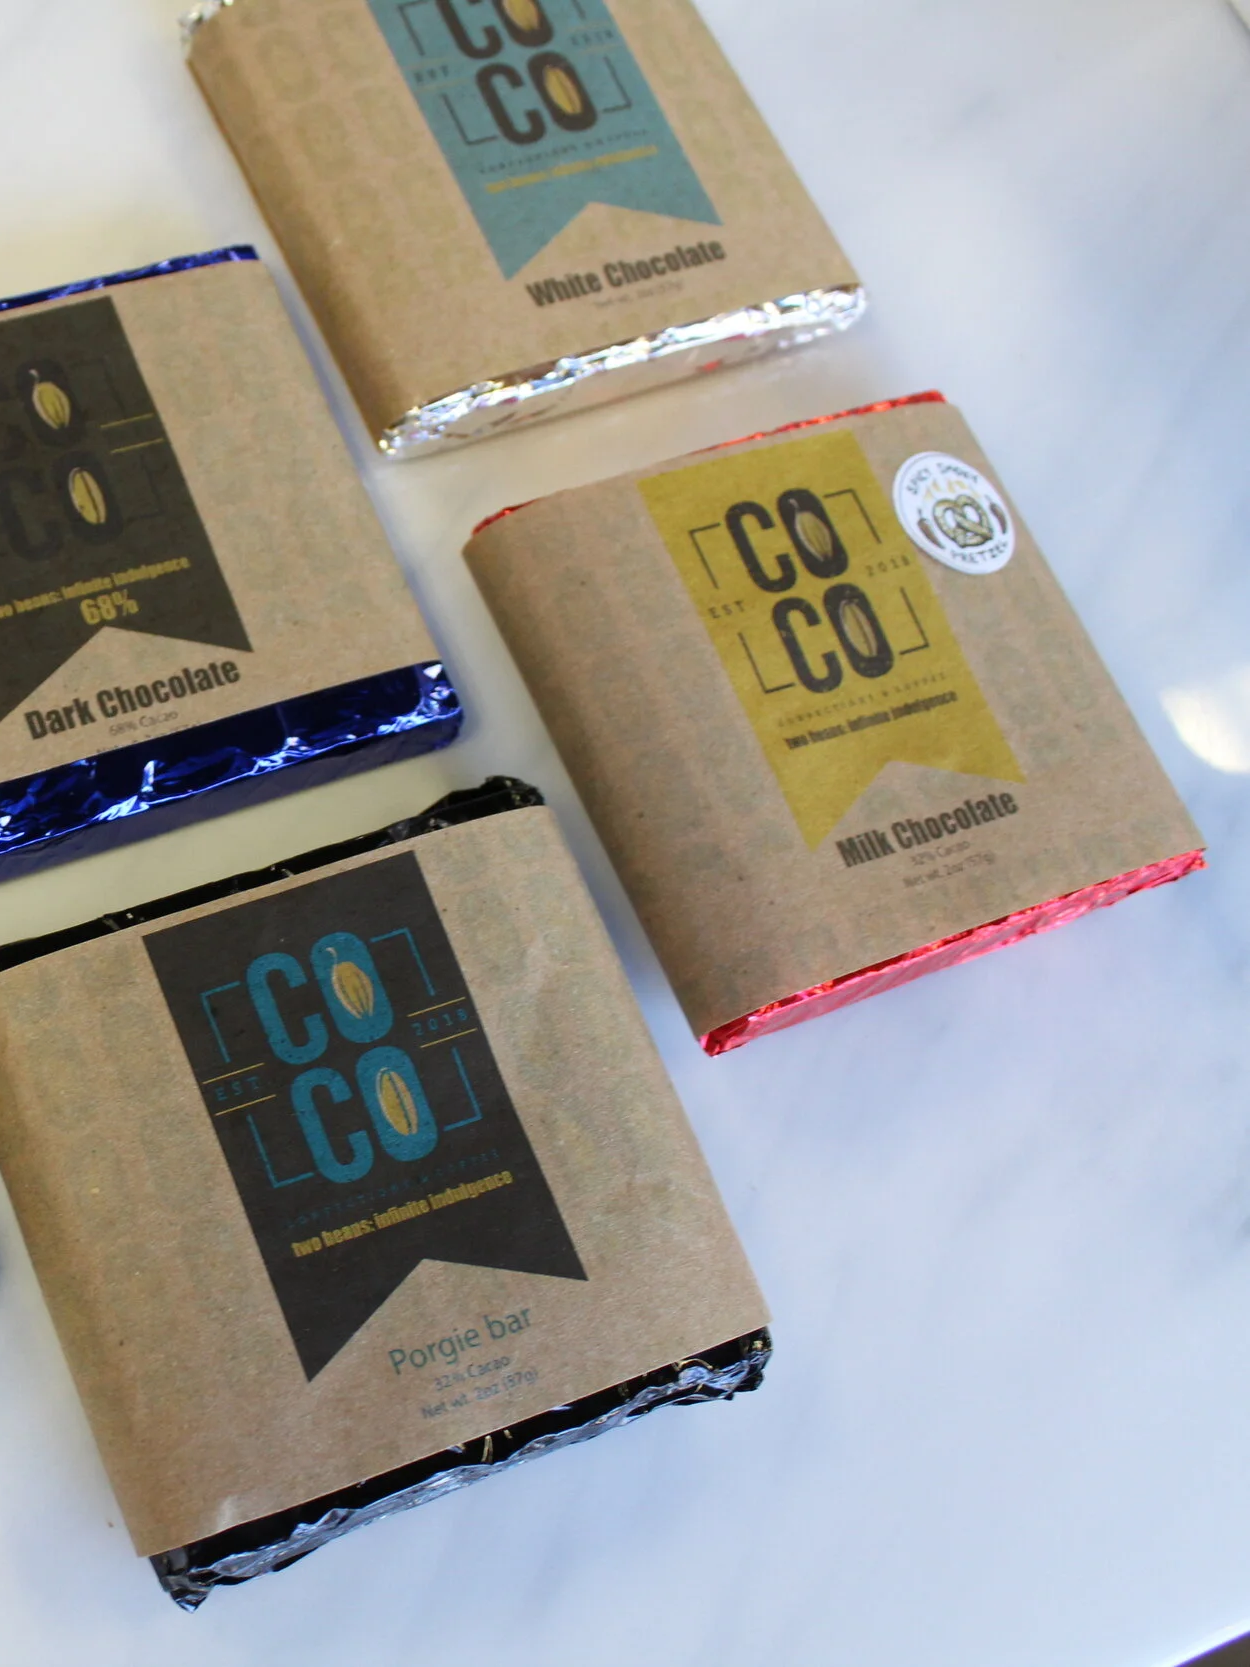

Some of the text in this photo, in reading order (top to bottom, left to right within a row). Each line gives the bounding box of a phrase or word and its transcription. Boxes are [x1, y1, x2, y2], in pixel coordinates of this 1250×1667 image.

[474, 50, 598, 146] CO
[526, 272, 603, 308] White
[603, 240, 727, 288] Chocolate
[724, 487, 849, 594] CO
[79, 589, 140, 626] 68%
[771, 582, 895, 694] CO
[24, 697, 97, 741] Dark
[96, 660, 241, 719] Chocolate
[138, 710, 179, 728] Cacao
[835, 792, 1020, 868] Milk Chocolate
[245, 930, 394, 1066] CO
[410, 1007, 469, 1037] 2018
[290, 1045, 439, 1184] CO
[290, 1169, 514, 1258] two beans: infinite indulgence
[388, 1307, 532, 1375] Porgie bar
[466, 1354, 511, 1379] Cacao
